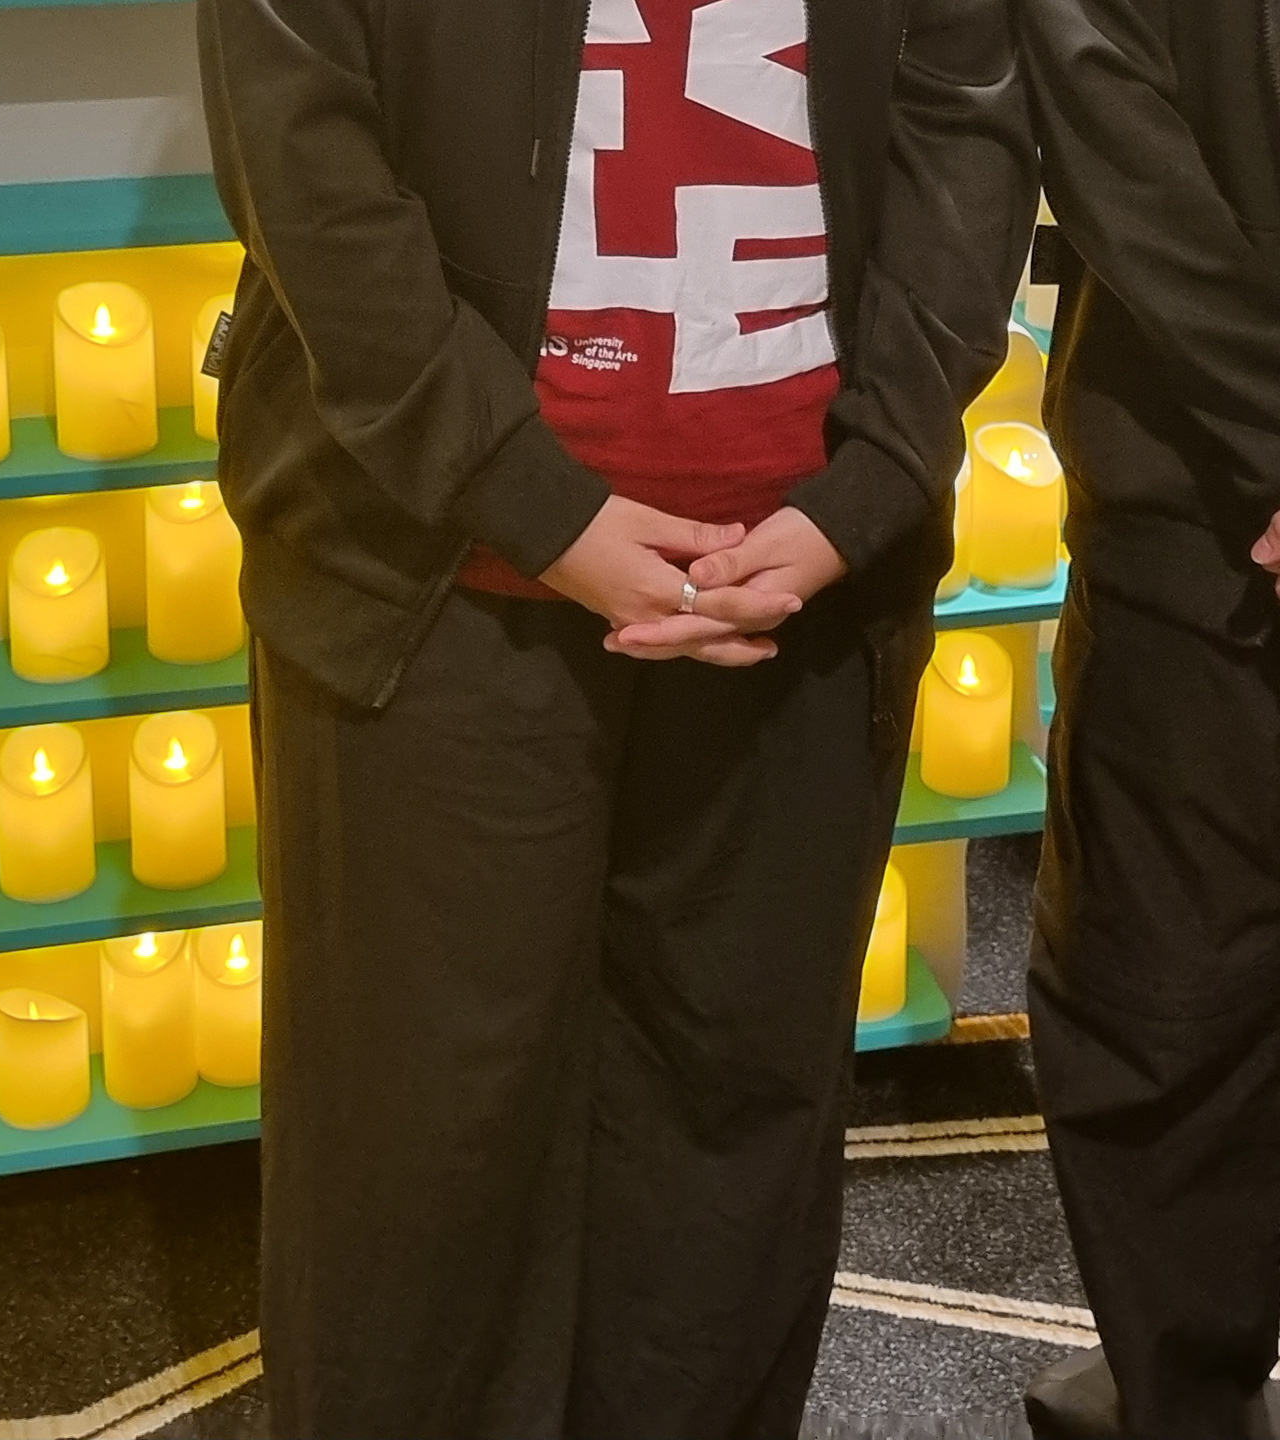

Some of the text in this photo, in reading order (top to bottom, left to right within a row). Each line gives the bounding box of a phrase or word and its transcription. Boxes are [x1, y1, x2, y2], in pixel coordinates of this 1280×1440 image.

[574, 336, 624, 349] University
[571, 353, 621, 371] Singapore
[585, 346, 639, 363] of the Arts
